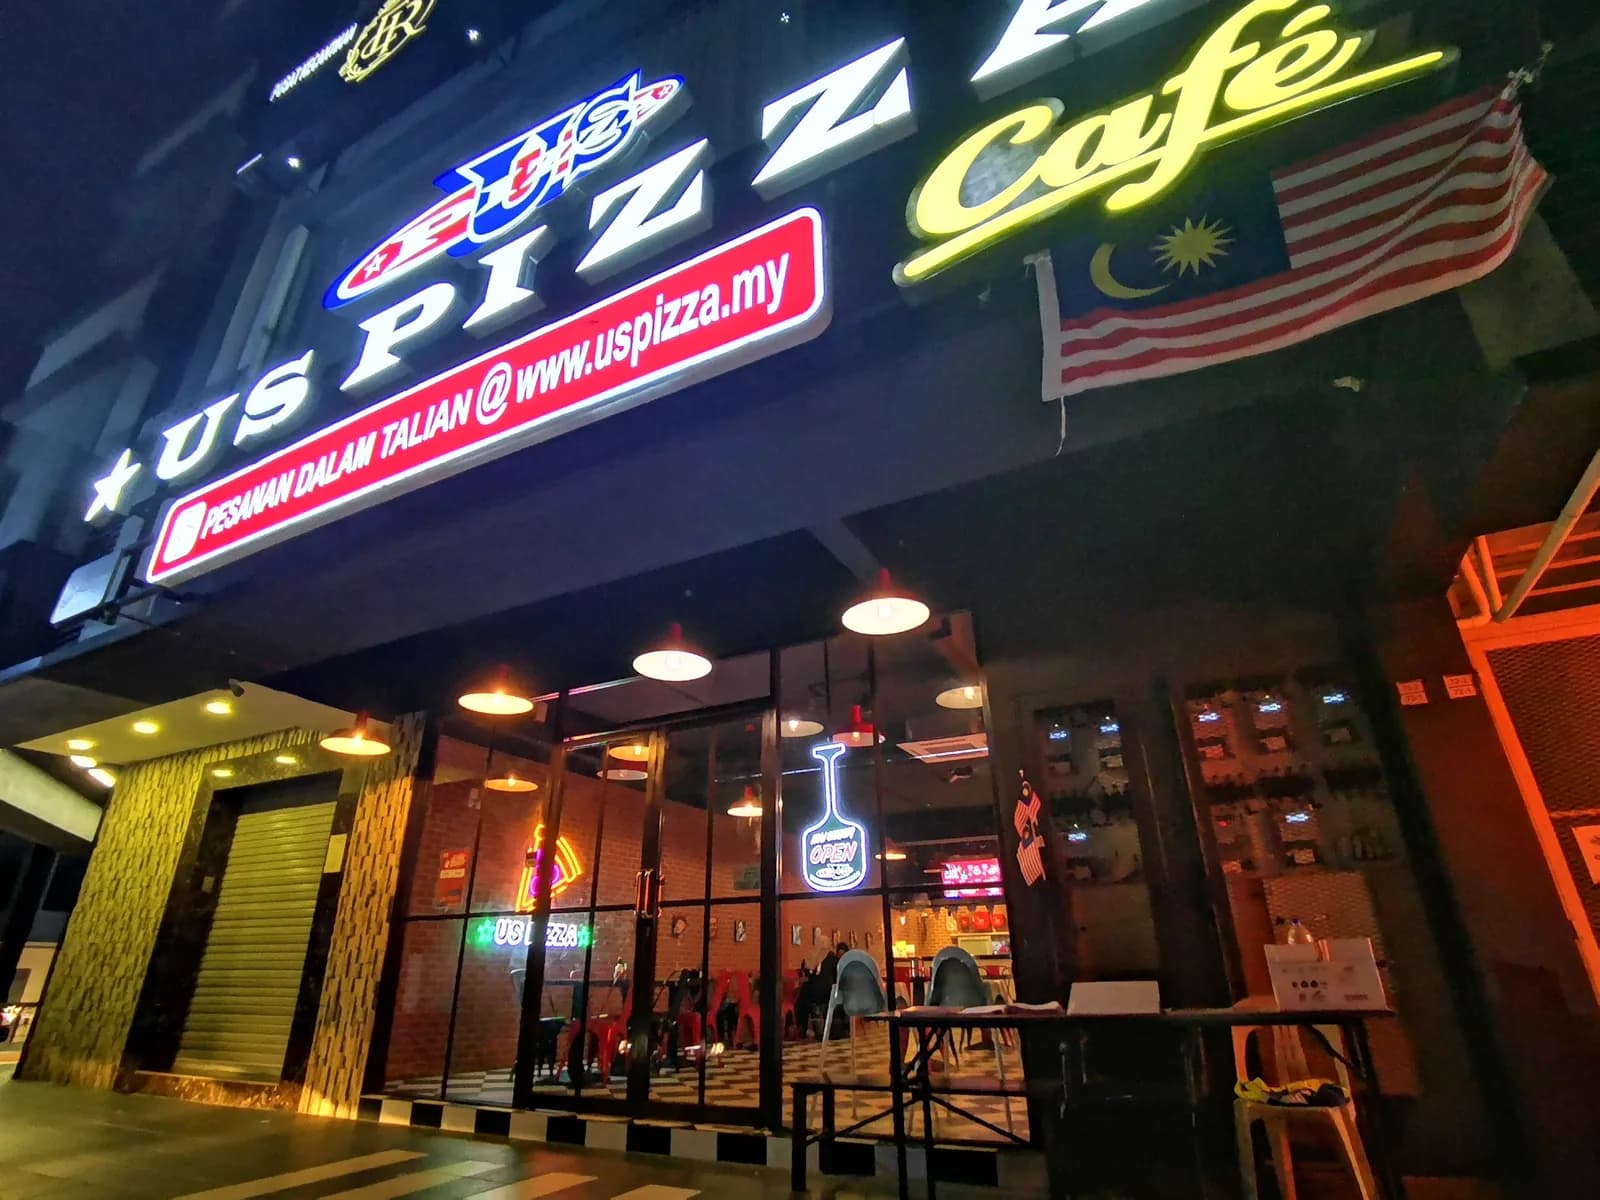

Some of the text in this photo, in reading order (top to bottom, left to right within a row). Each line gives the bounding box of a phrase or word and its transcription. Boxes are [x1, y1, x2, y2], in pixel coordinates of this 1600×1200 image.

[915, 0, 1362, 234] Café
[156, 348, 313, 480] US
[200, 469, 296, 539] PESANAN
[293, 431, 378, 498] DALAM
[380, 389, 474, 459] TALIAN
[516, 253, 789, 403] www.uspizza.my
[810, 841, 857, 864] OPEN
[494, 919, 525, 945] US
